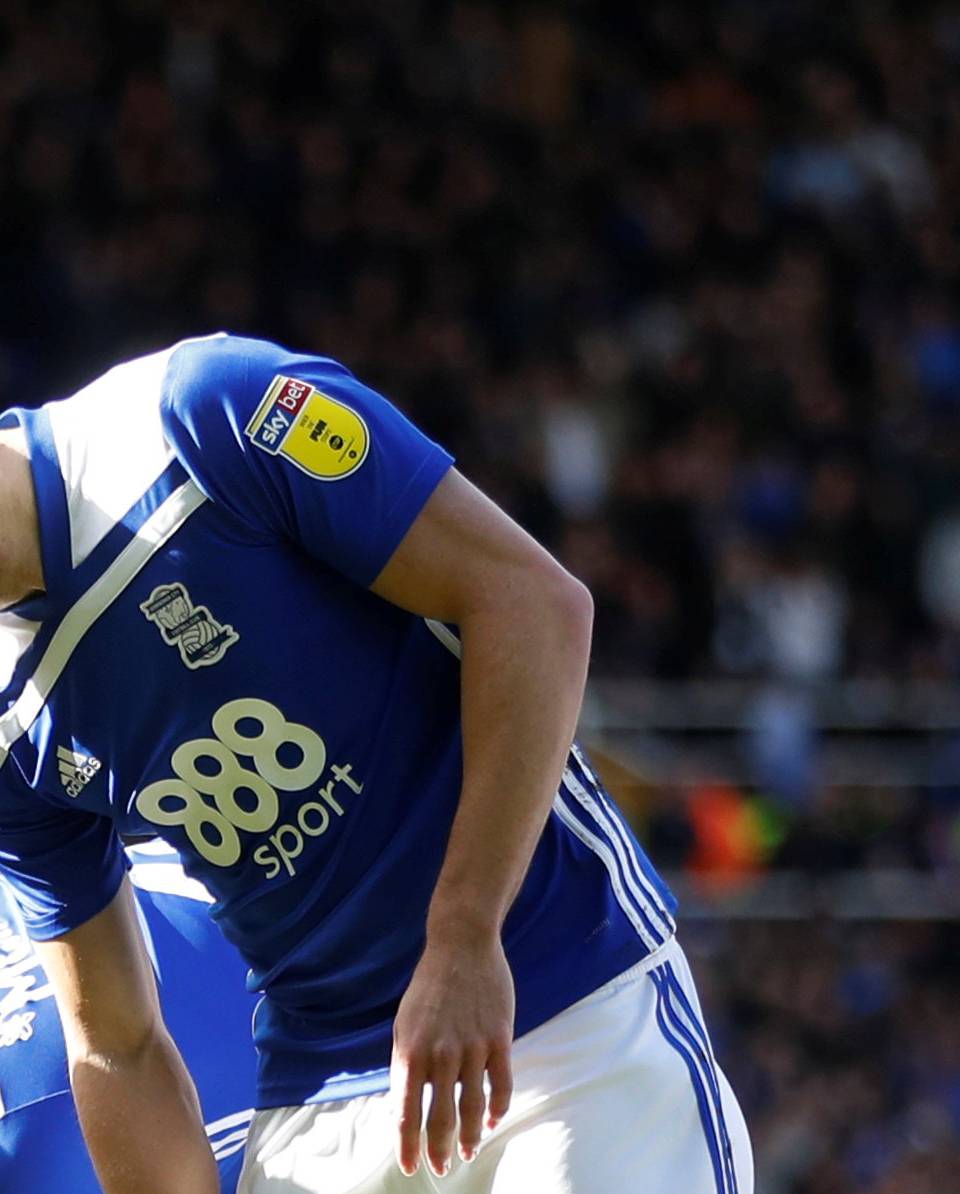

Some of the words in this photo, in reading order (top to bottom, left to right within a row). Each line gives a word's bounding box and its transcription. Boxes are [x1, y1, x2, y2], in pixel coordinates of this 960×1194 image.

[262, 408, 290, 445] sky
[277, 381, 307, 411] bet
[66, 757, 101, 798] adidas
[136, 698, 326, 868] 888
[253, 763, 364, 879] sport
